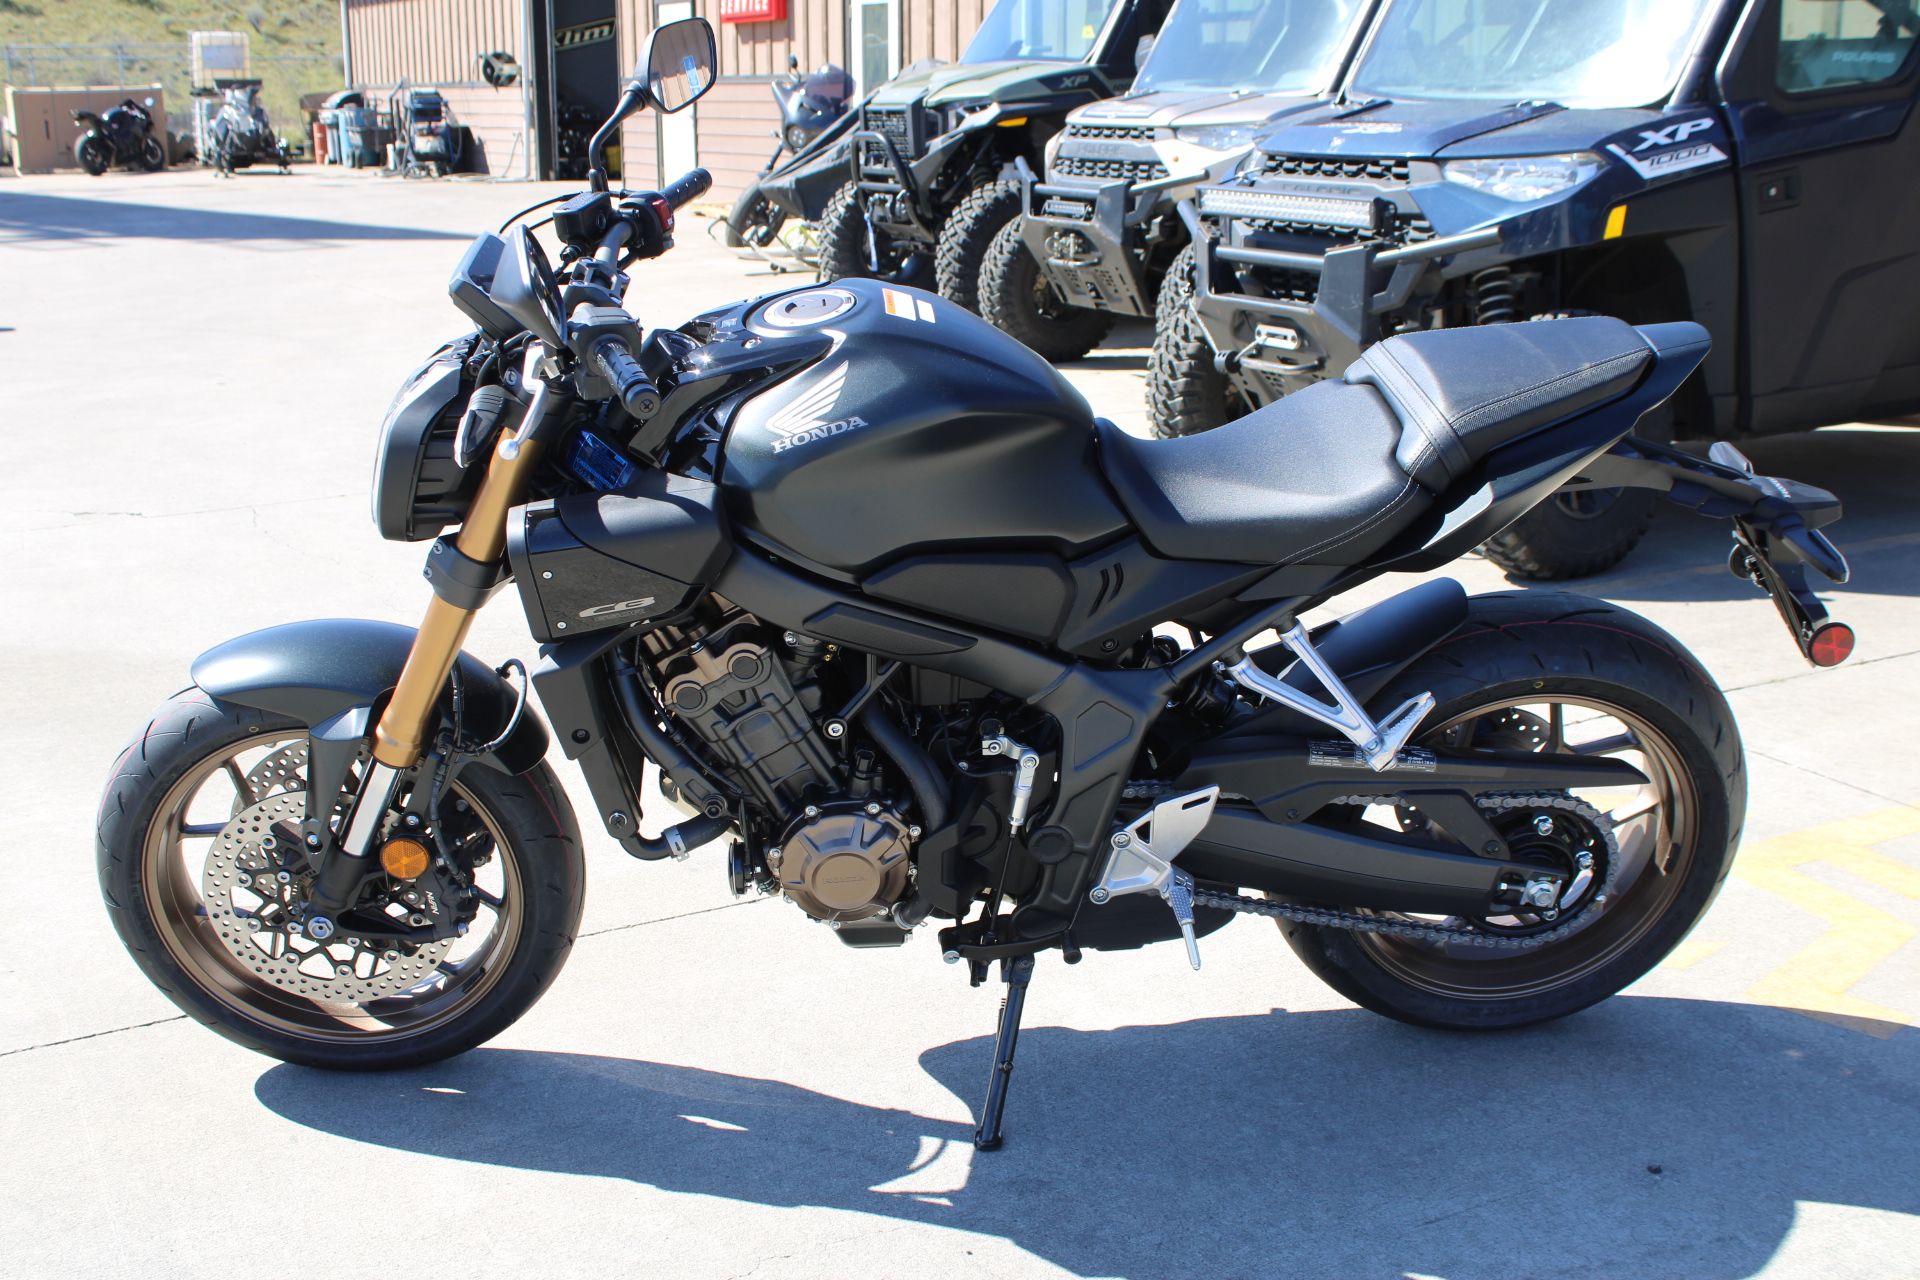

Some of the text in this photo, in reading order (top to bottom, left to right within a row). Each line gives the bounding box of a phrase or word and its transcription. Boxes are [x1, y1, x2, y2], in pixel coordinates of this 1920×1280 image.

[1060, 75, 1089, 88] XP
[1631, 117, 1715, 152] XP
[1648, 142, 1713, 167] 1000
[770, 416, 869, 454] HONDA
[579, 596, 656, 618] CB
